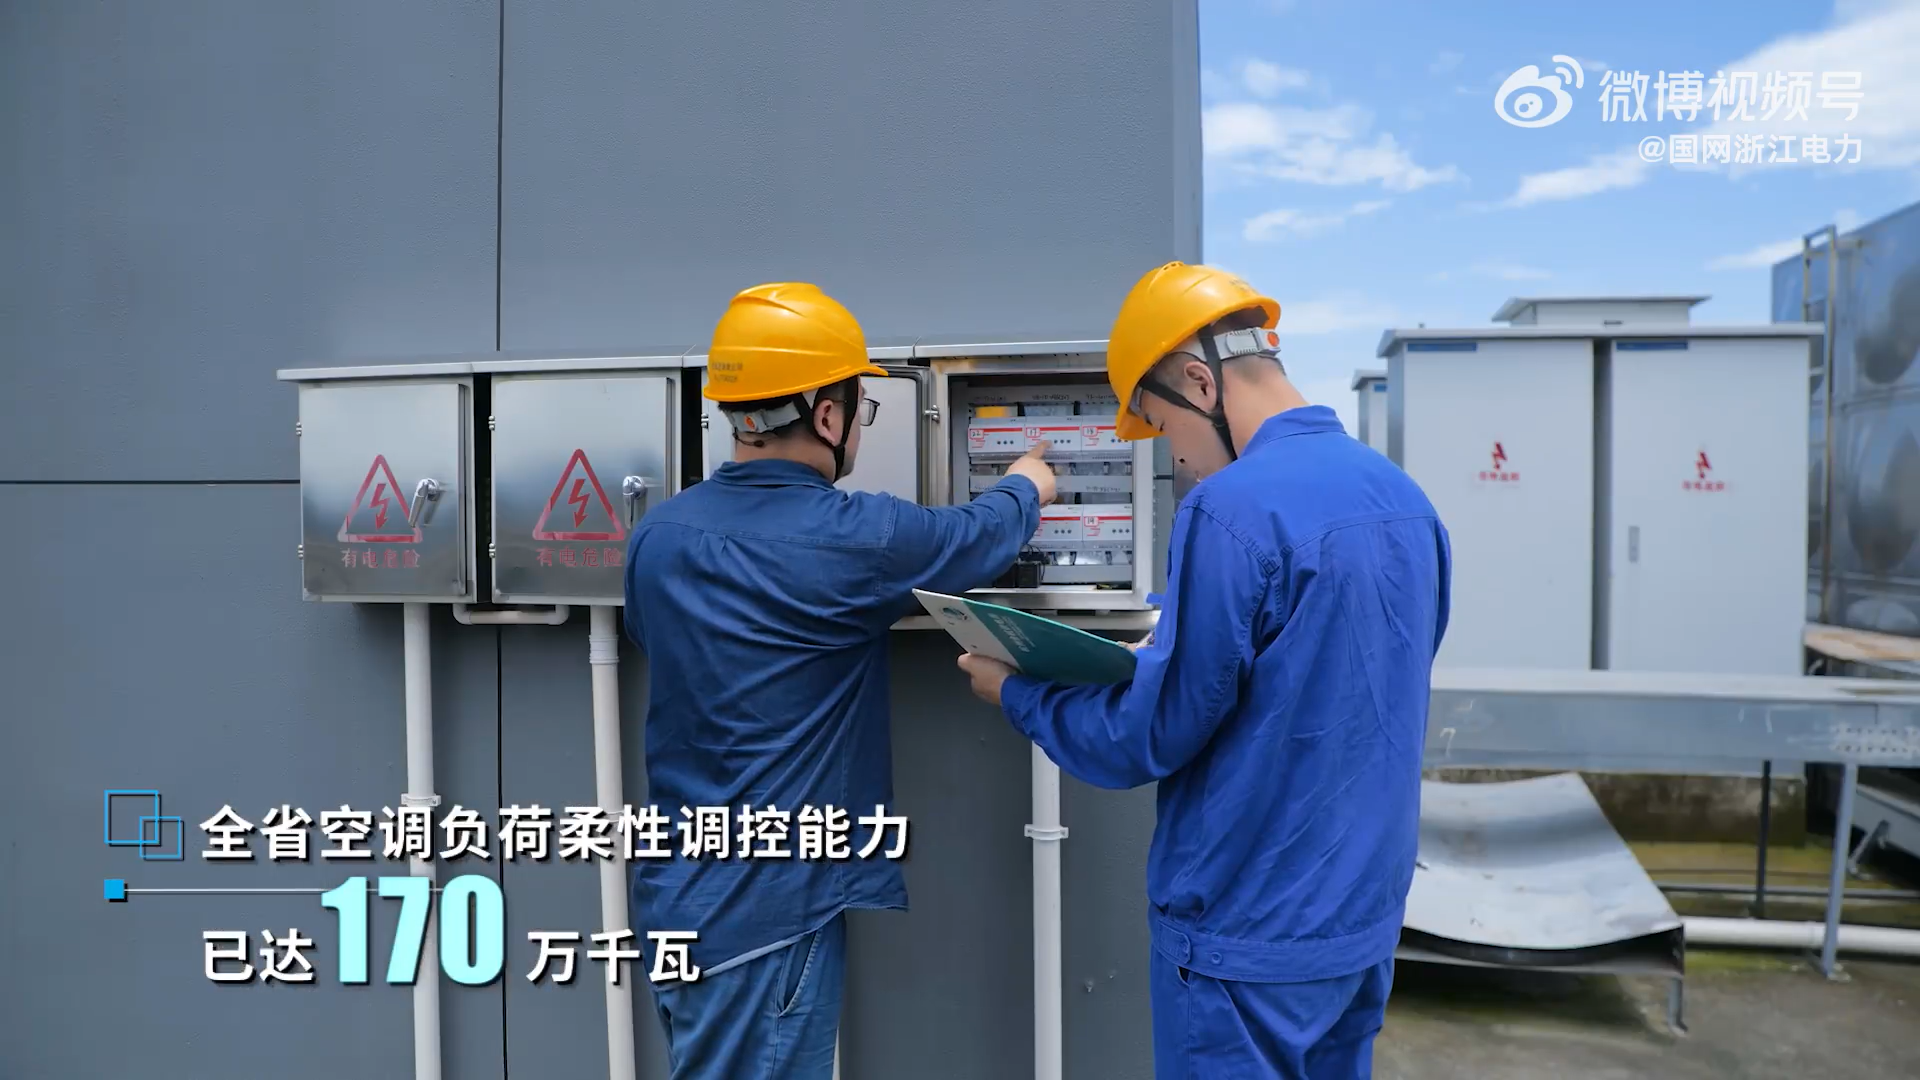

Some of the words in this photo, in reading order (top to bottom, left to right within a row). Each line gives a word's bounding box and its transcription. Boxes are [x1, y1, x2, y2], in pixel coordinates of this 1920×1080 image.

[340, 548, 421, 569] 有电危险
[536, 547, 623, 568] 有电危险
